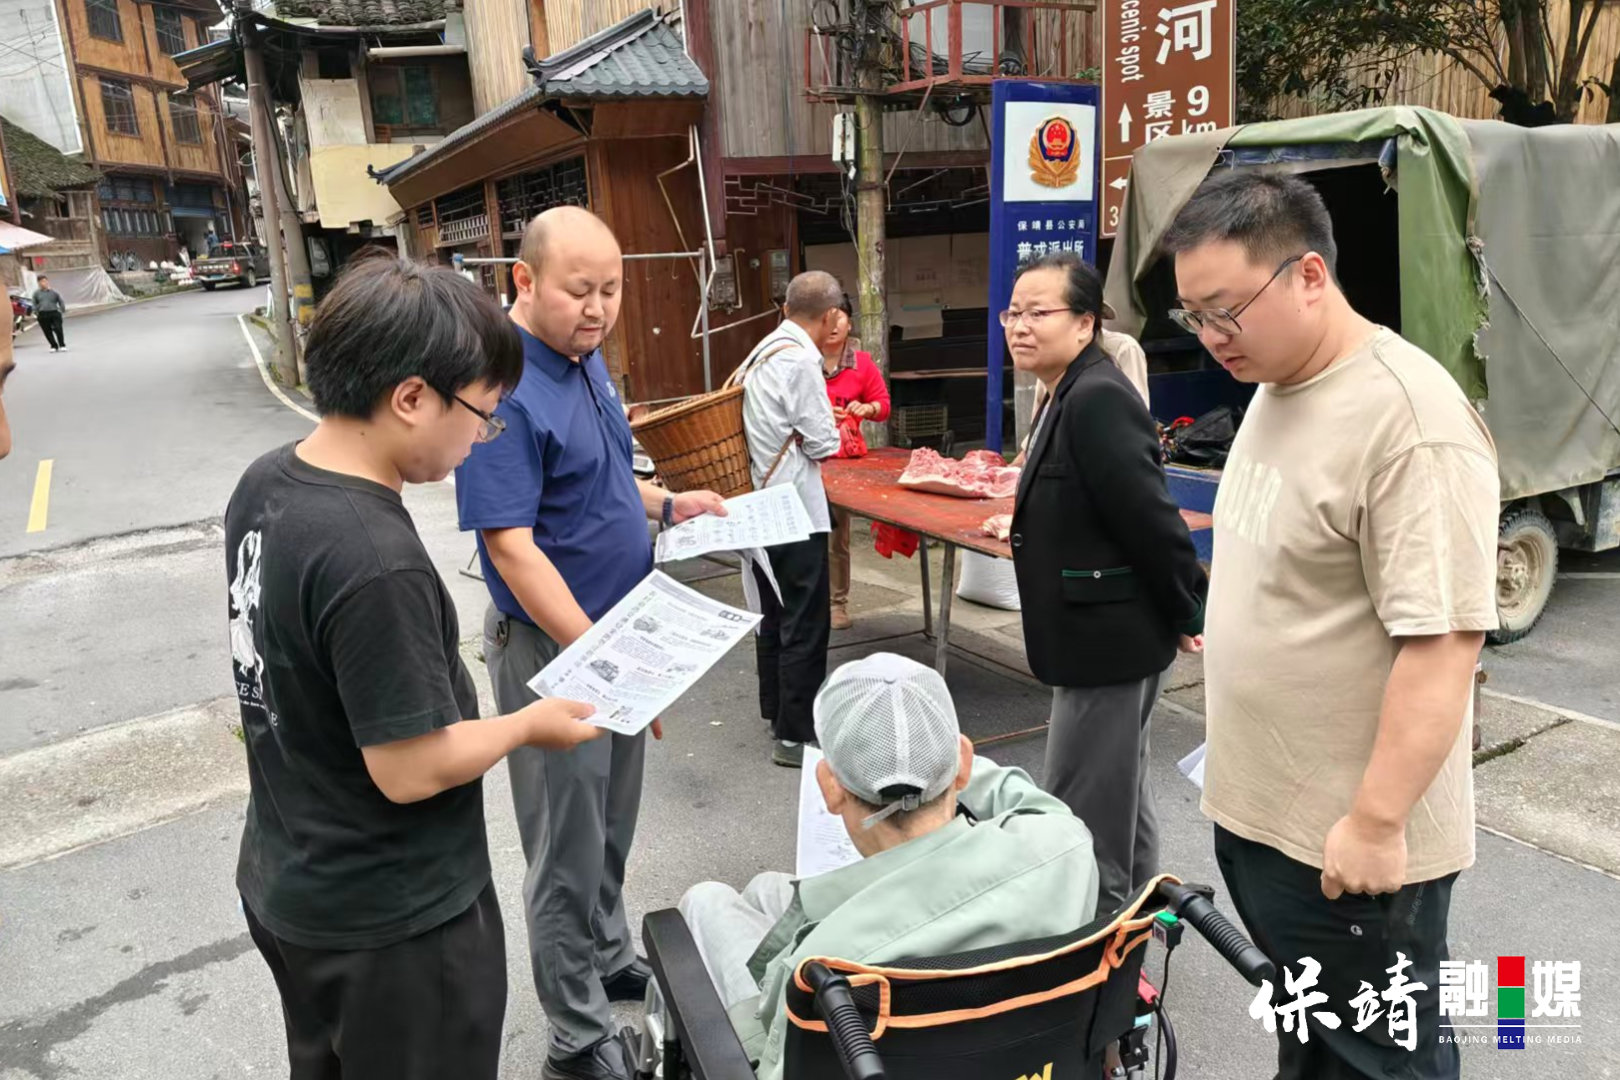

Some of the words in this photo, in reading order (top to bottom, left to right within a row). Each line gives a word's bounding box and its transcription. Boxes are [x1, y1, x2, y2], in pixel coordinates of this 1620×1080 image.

[1154, 0, 1217, 65] 河
[1115, 45, 1144, 83] spot
[1142, 89, 1176, 145] 景区
[1187, 85, 1210, 116] 9
[1017, 219, 1085, 231] 保靖县公安局
